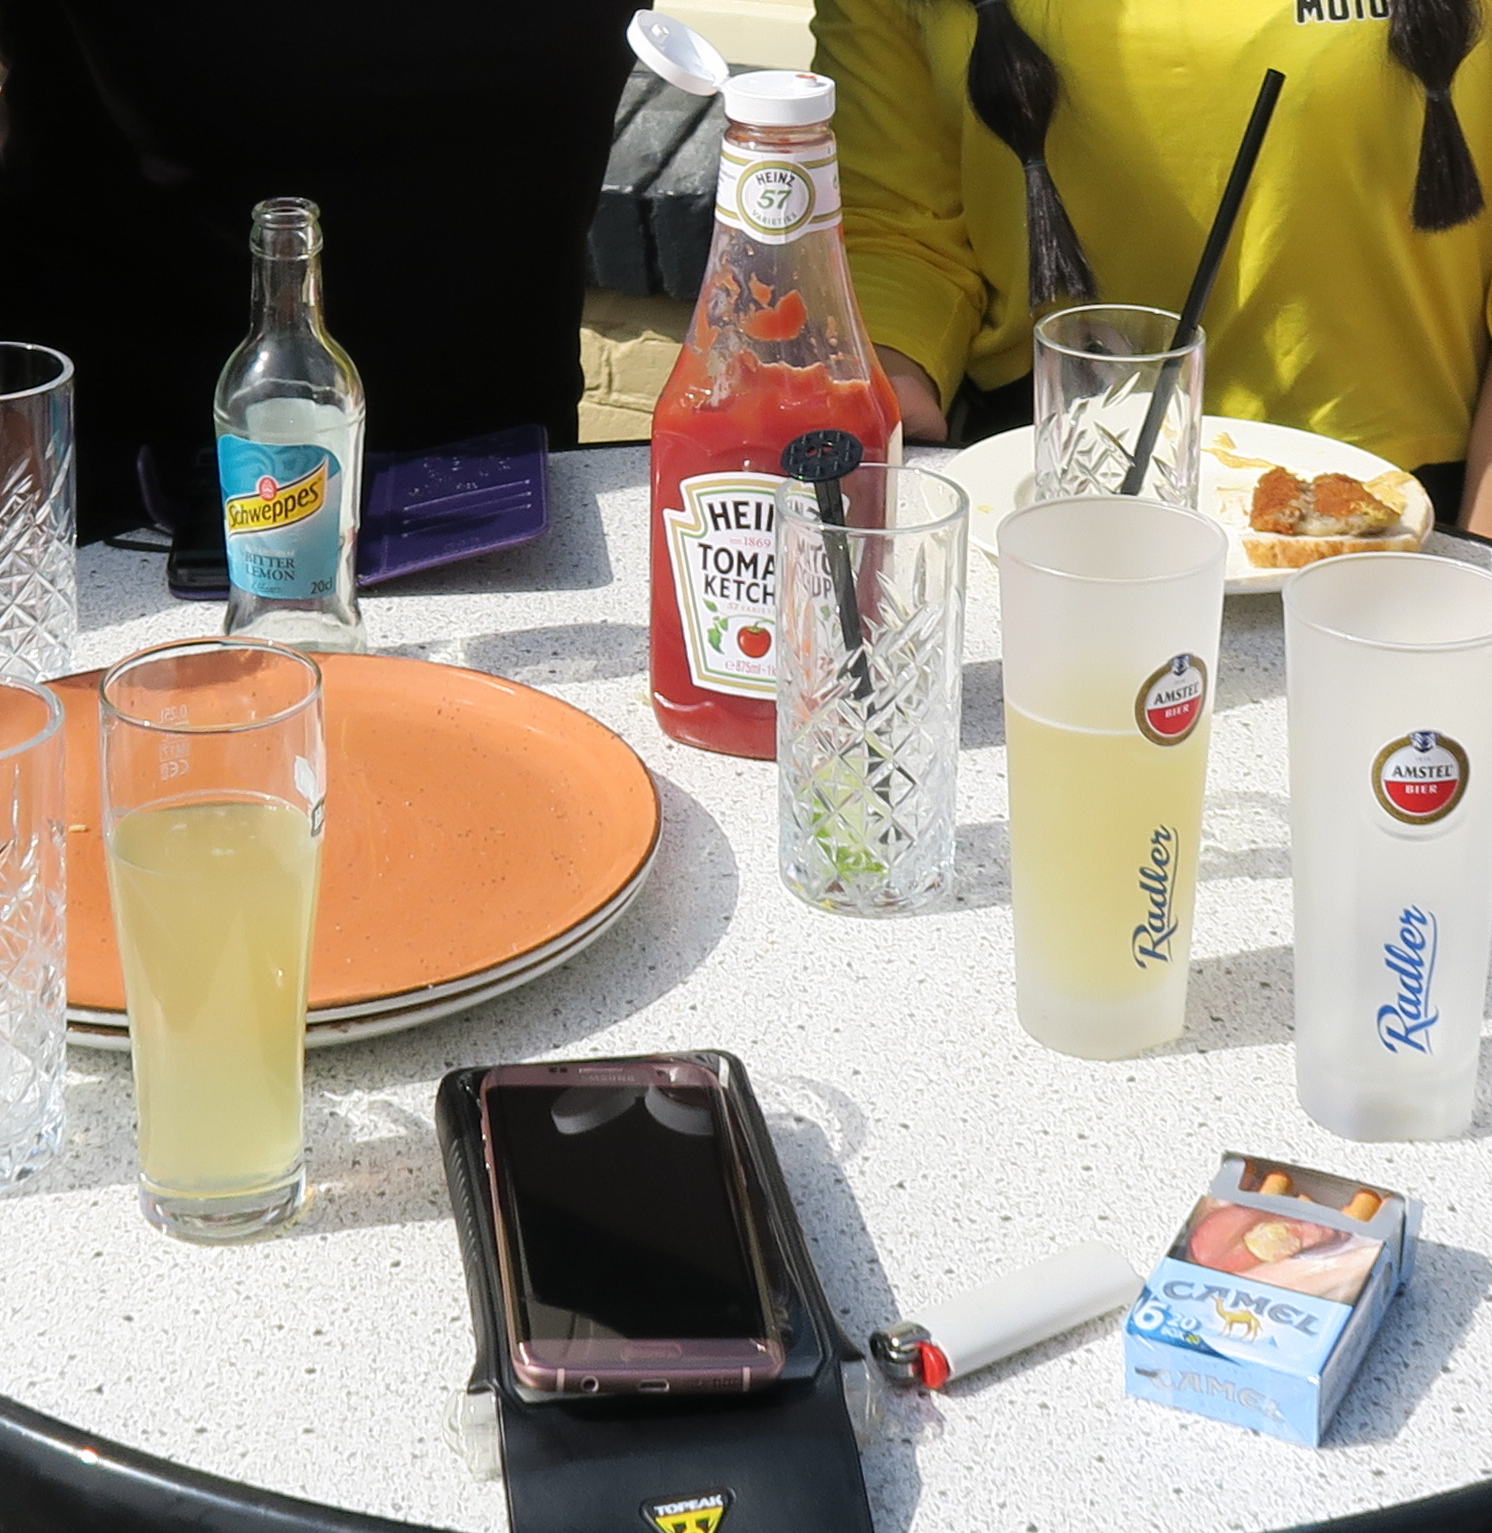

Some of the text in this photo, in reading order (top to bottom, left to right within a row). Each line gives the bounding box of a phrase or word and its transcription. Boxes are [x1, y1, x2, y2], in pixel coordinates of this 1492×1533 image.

[756, 171, 795, 187] HEINZ
[757, 189, 792, 209] 57
[229, 483, 318, 526] Schweppes
[744, 536, 771, 548] 1869
[245, 551, 295, 569] BITTER
[246, 564, 295, 581] LEMON
[310, 577, 333, 595] 20cl
[1153, 681, 1199, 706] AMSTEL
[1164, 703, 1190, 719] BIER
[1391, 764, 1452, 779] AMSTEL
[1405, 784, 1438, 795] BIER
[1132, 824, 1179, 969] Radler
[1377, 905, 1439, 1055] Radler
[1162, 1279, 1320, 1336] CAMEL
[1150, 1368, 1286, 1425] CAMEL
[653, 1494, 724, 1517] TOPEAK
